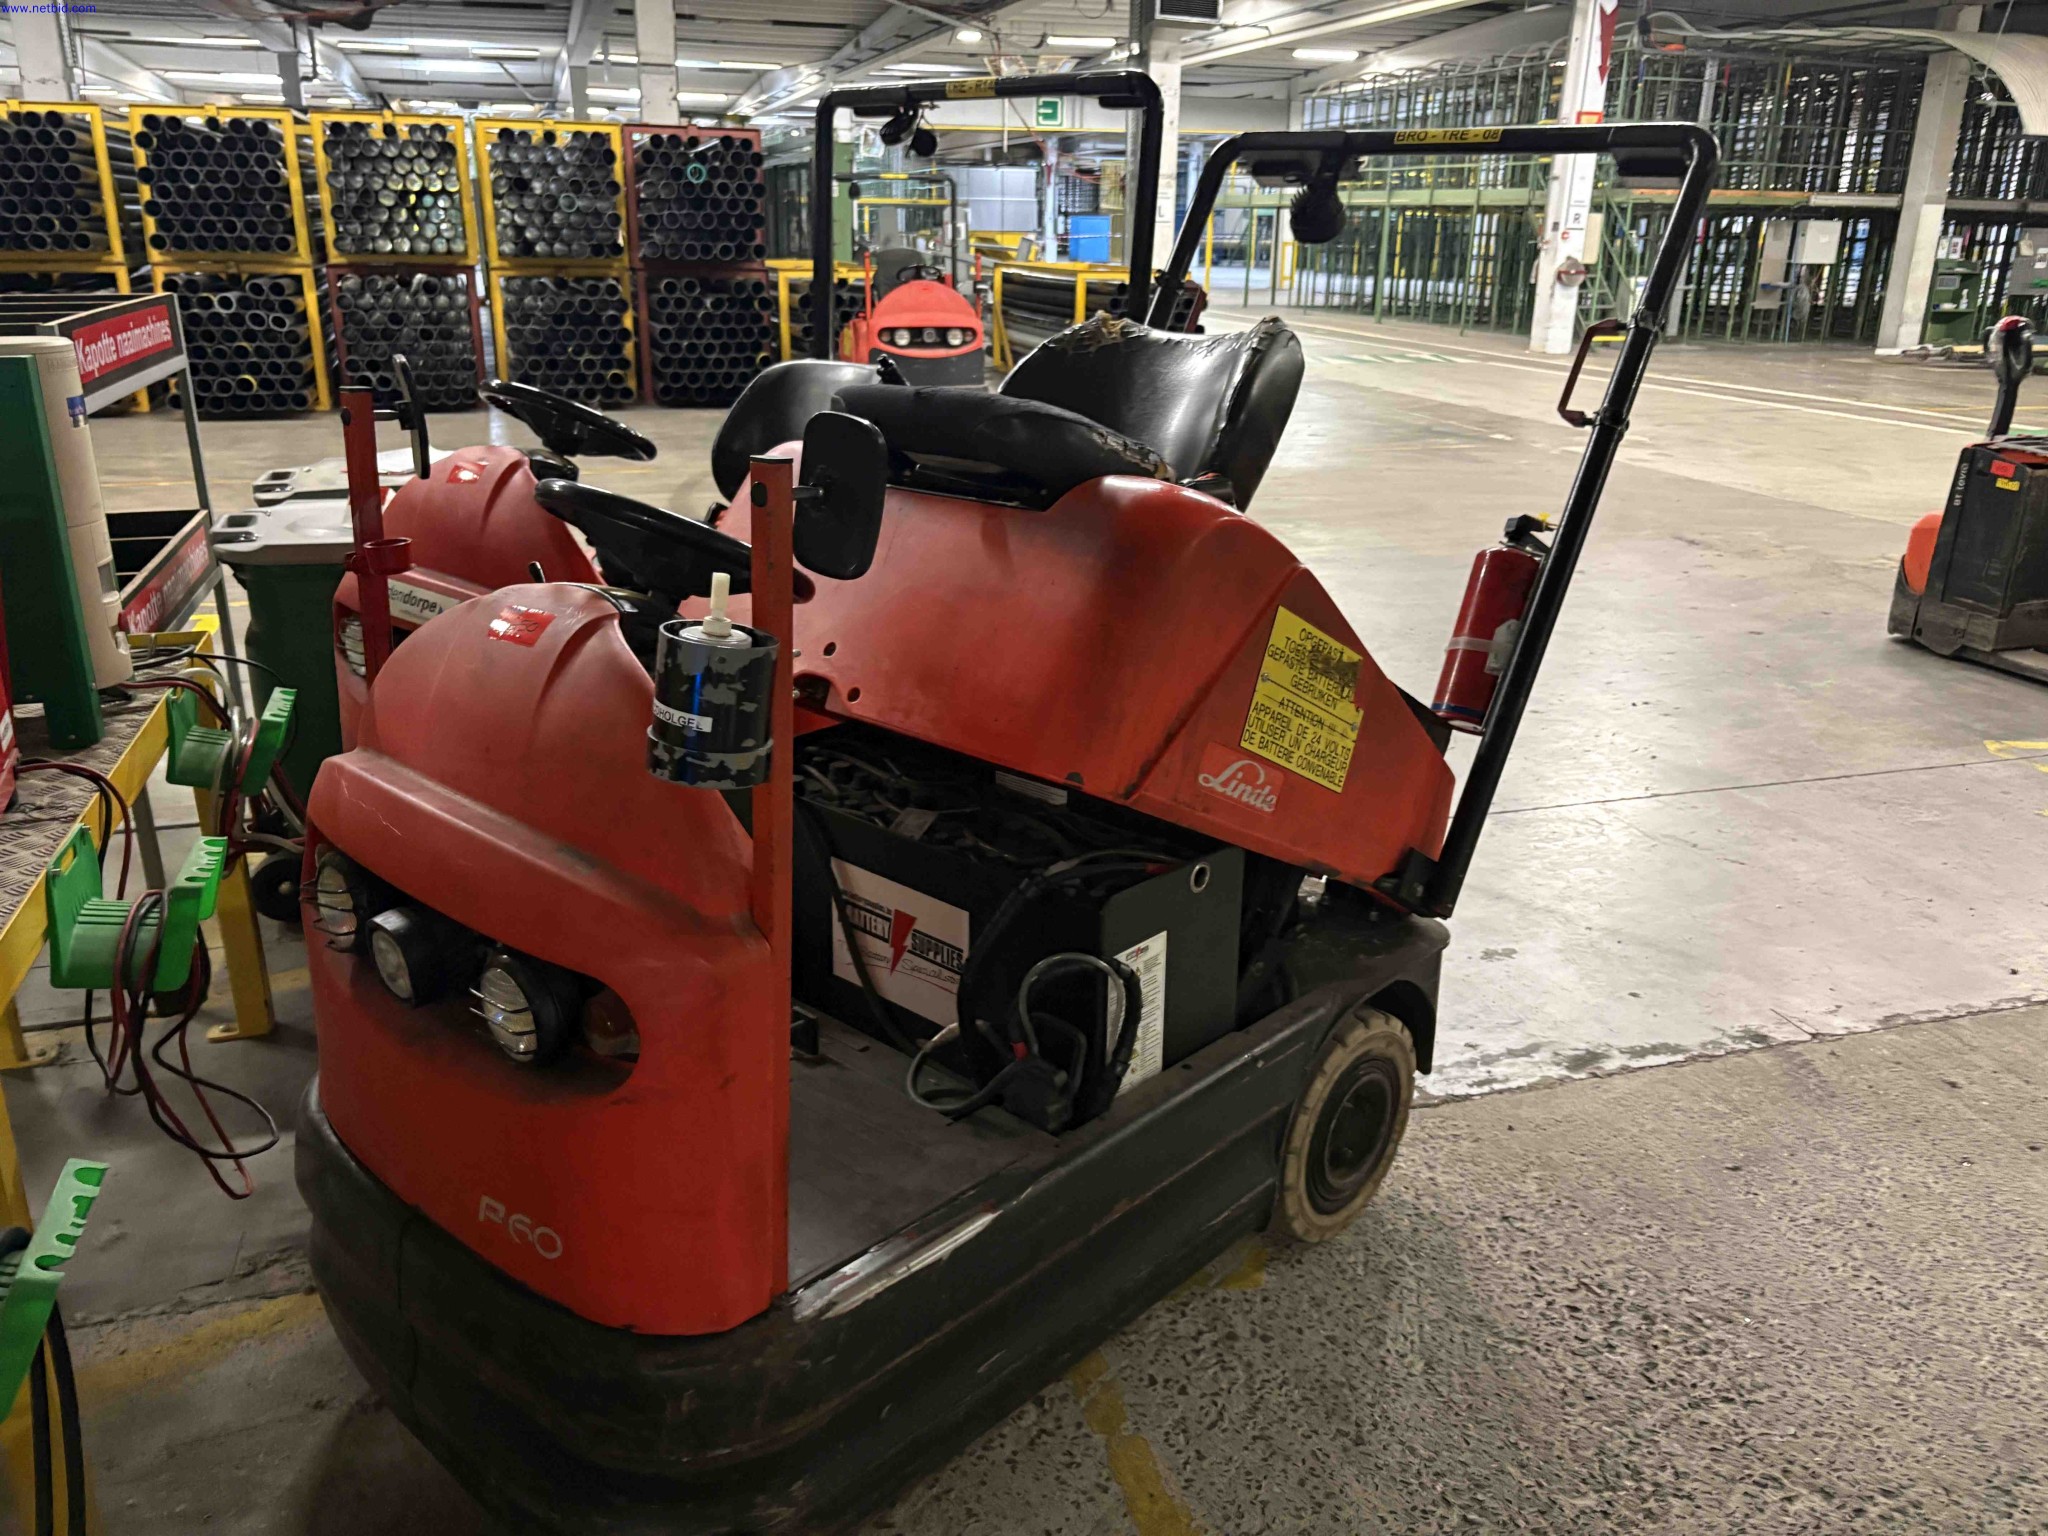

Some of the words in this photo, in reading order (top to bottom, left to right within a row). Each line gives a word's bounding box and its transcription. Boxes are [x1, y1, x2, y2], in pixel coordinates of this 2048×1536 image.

[1397, 131, 1428, 142] BRO
[1442, 130, 1471, 141] TRE
[1482, 129, 1501, 140] 08
[75, 337, 118, 378] Kapotte
[116, 315, 172, 358] naaimachines
[1268, 644, 1306, 674] GEPASTE
[1252, 701, 1292, 732] APPAREIL
[1296, 723, 1310, 740] DE
[1310, 731, 1322, 745] 24
[1324, 738, 1352, 761] VOLTS
[1279, 696, 1325, 730] ATTENTION
[1242, 728, 1256, 746] DE
[1257, 738, 1295, 764] BATTERIE
[1296, 754, 1344, 787] CONVENABLE
[1248, 714, 1286, 743] UTILISER
[1288, 734, 1302, 751] UN
[1303, 742, 1348, 772] CHARGEUR
[1198, 760, 1278, 812] Linde
[911, 931, 964, 973] SUPPLIES
[479, 1194, 563, 1260] P60
